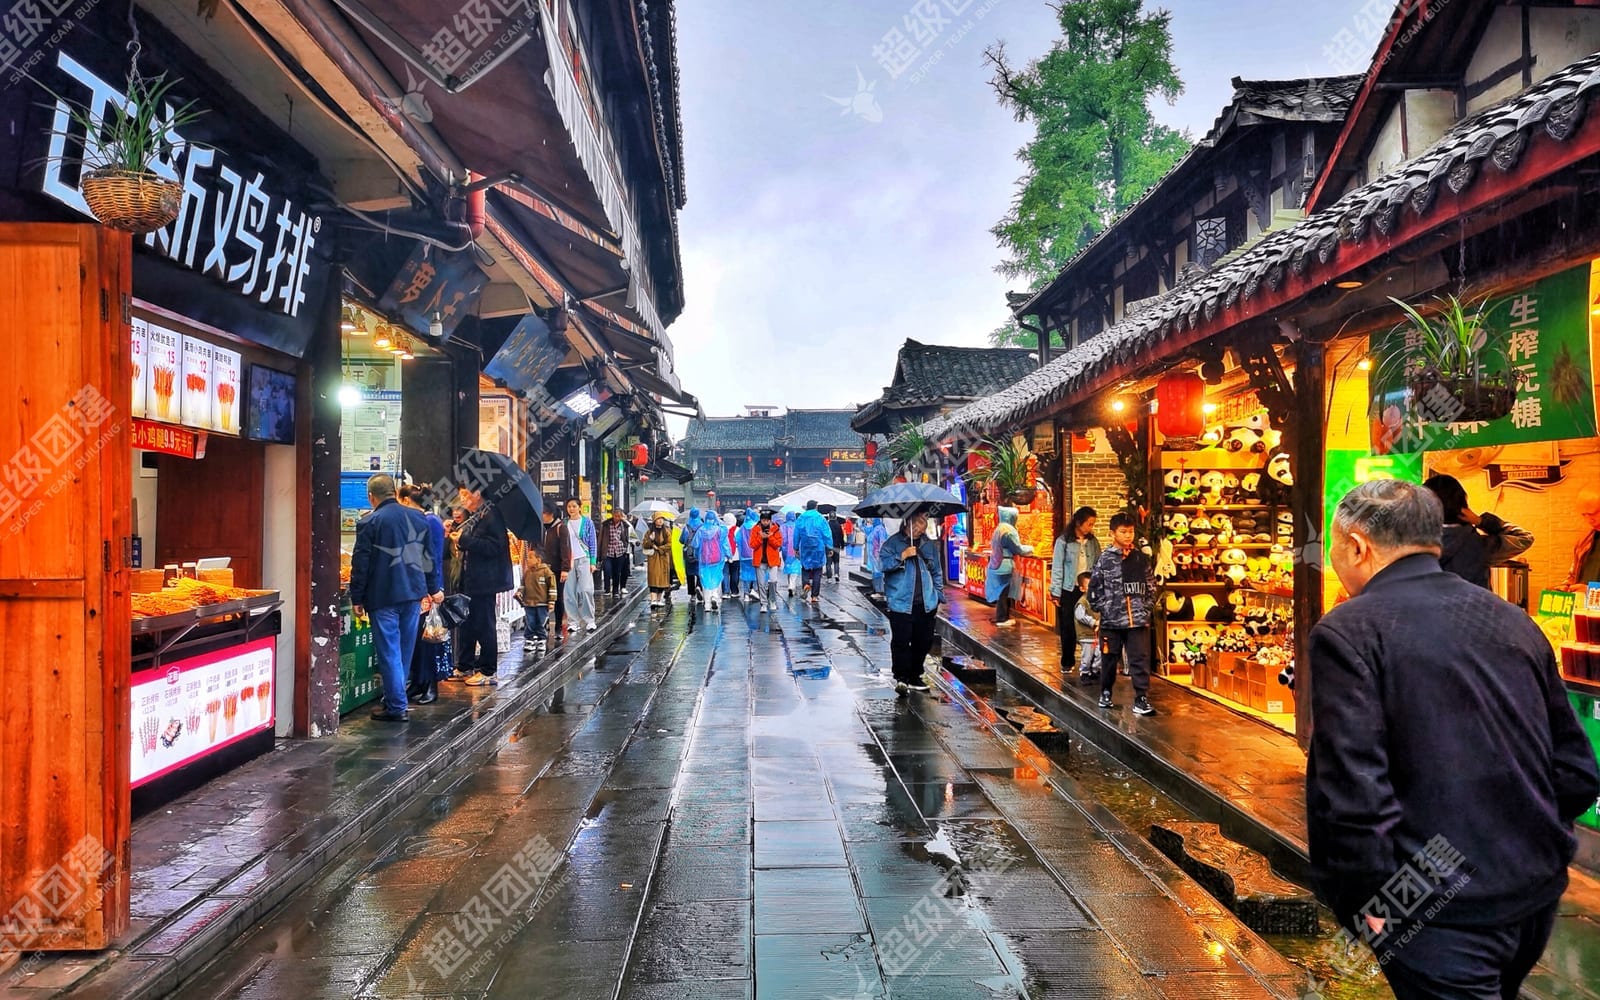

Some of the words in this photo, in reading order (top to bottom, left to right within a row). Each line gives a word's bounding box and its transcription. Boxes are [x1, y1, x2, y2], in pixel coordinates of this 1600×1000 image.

[167, 350, 175, 364] 15
[199, 359, 207, 373] 12
[228, 369, 236, 382] 12
